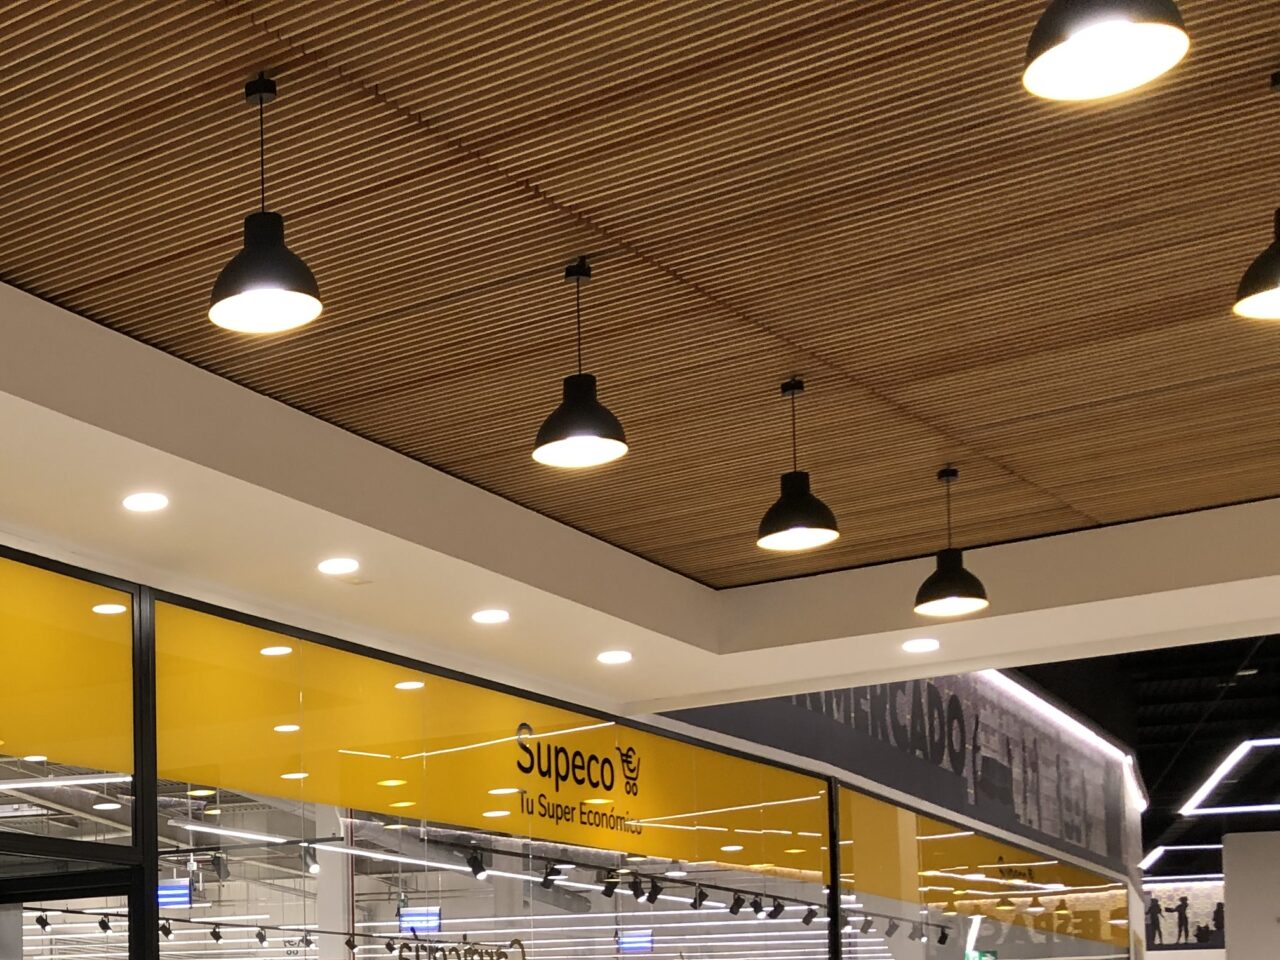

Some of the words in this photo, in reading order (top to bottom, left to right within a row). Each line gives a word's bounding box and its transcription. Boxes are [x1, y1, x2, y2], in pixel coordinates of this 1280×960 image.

[516, 722, 615, 792] Supeco
[519, 789, 534, 815] Tu
[537, 793, 577, 825] Super
[579, 801, 643, 835] Económico
